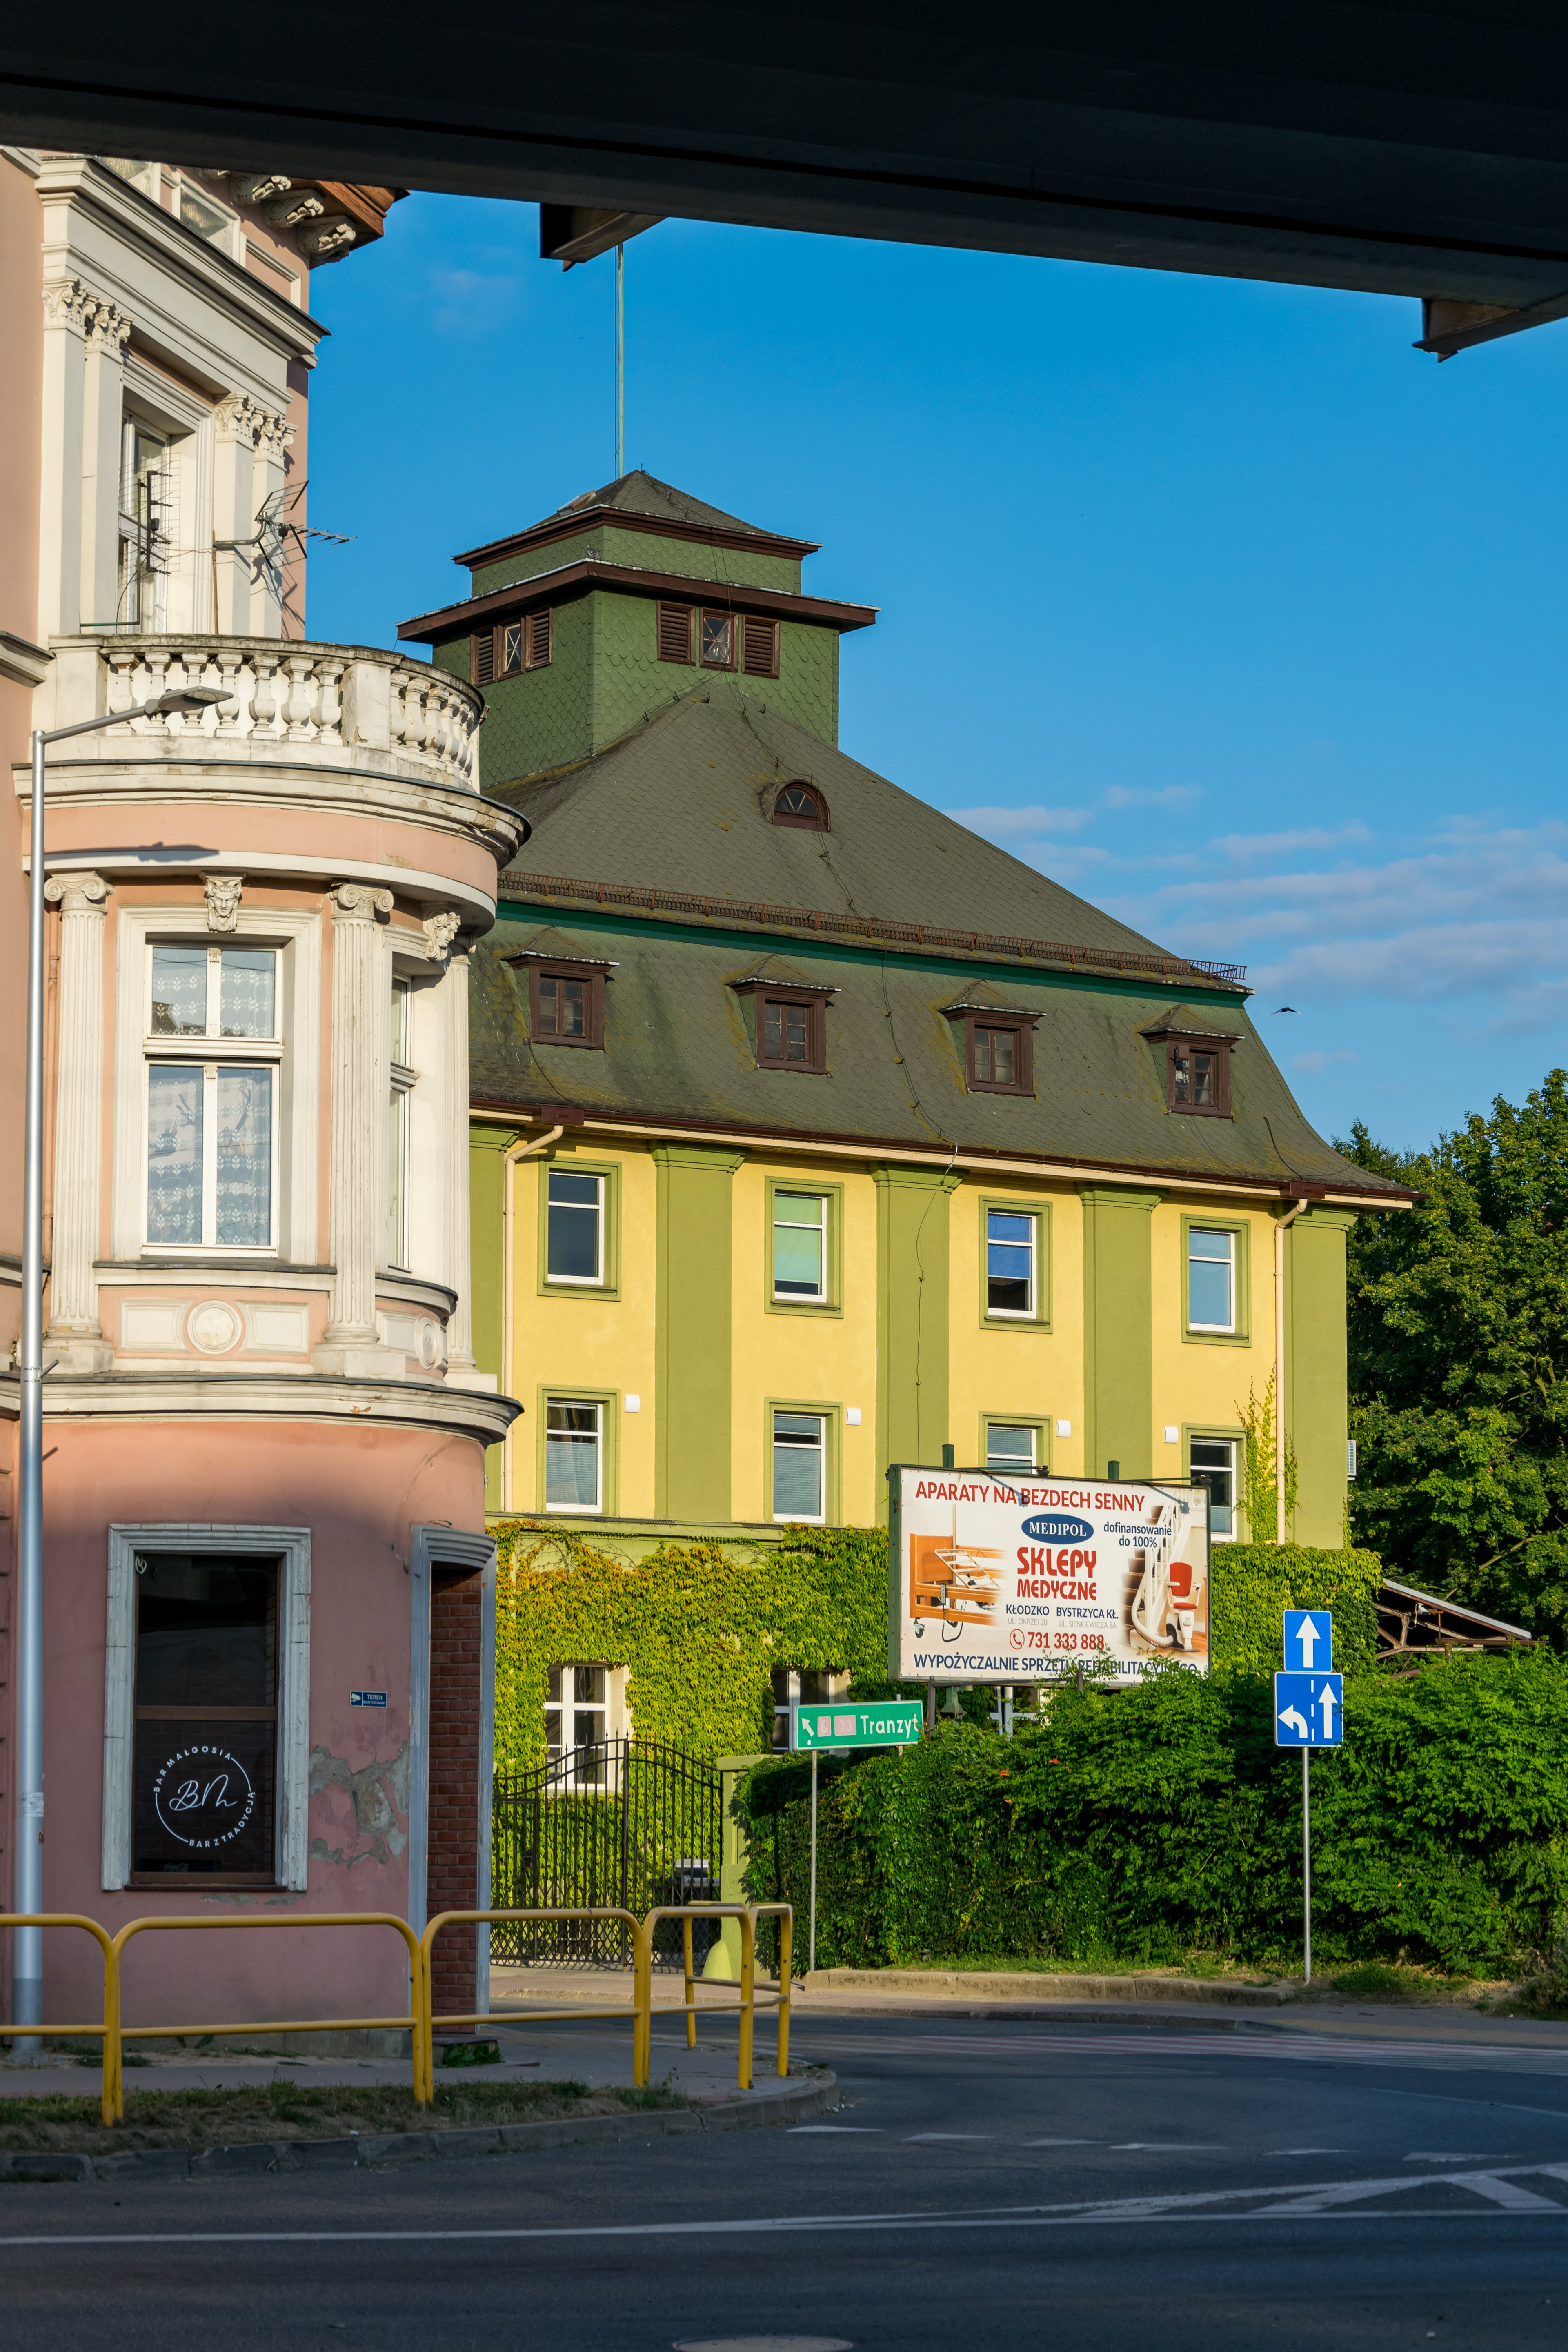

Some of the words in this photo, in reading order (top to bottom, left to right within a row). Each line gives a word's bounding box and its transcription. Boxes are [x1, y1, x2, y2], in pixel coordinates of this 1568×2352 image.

[916, 1481, 989, 1502] APARATY
[994, 1486, 1016, 1504] NA
[1021, 1488, 1090, 1509] BEZDECH
[1095, 1493, 1145, 1511] SENNY
[1029, 1522, 1087, 1537] MEDIPOL
[1103, 1521, 1172, 1535] dofinansowanie
[1119, 1535, 1130, 1546] do
[1133, 1536, 1157, 1548] 100%
[1017, 1547, 1096, 1578] SKLEPY
[1017, 1579, 1096, 1600] MEDYCZNE
[1006, 1604, 1050, 1615] KŁODZKO
[1056, 1607, 1104, 1618] BYSTRZYCA
[1107, 1609, 1119, 1619] KŁ.
[1069, 1620, 1108, 1629] SIENKIEWICZA
[1027, 1631, 1050, 1649] 731
[1054, 1633, 1077, 1649] 333
[1081, 1634, 1104, 1651] 888
[914, 1652, 1019, 1671] WYPOŻYCZALNIE
[839, 1718, 852, 1732] 33
[860, 1713, 919, 1739] Tranzyt
[153, 1769, 167, 1792] BAR
[167, 1746, 231, 1768] MAŁGOSIA
[189, 1839, 210, 1847] BAR
[221, 1792, 255, 1842] TRADYCJĄ
